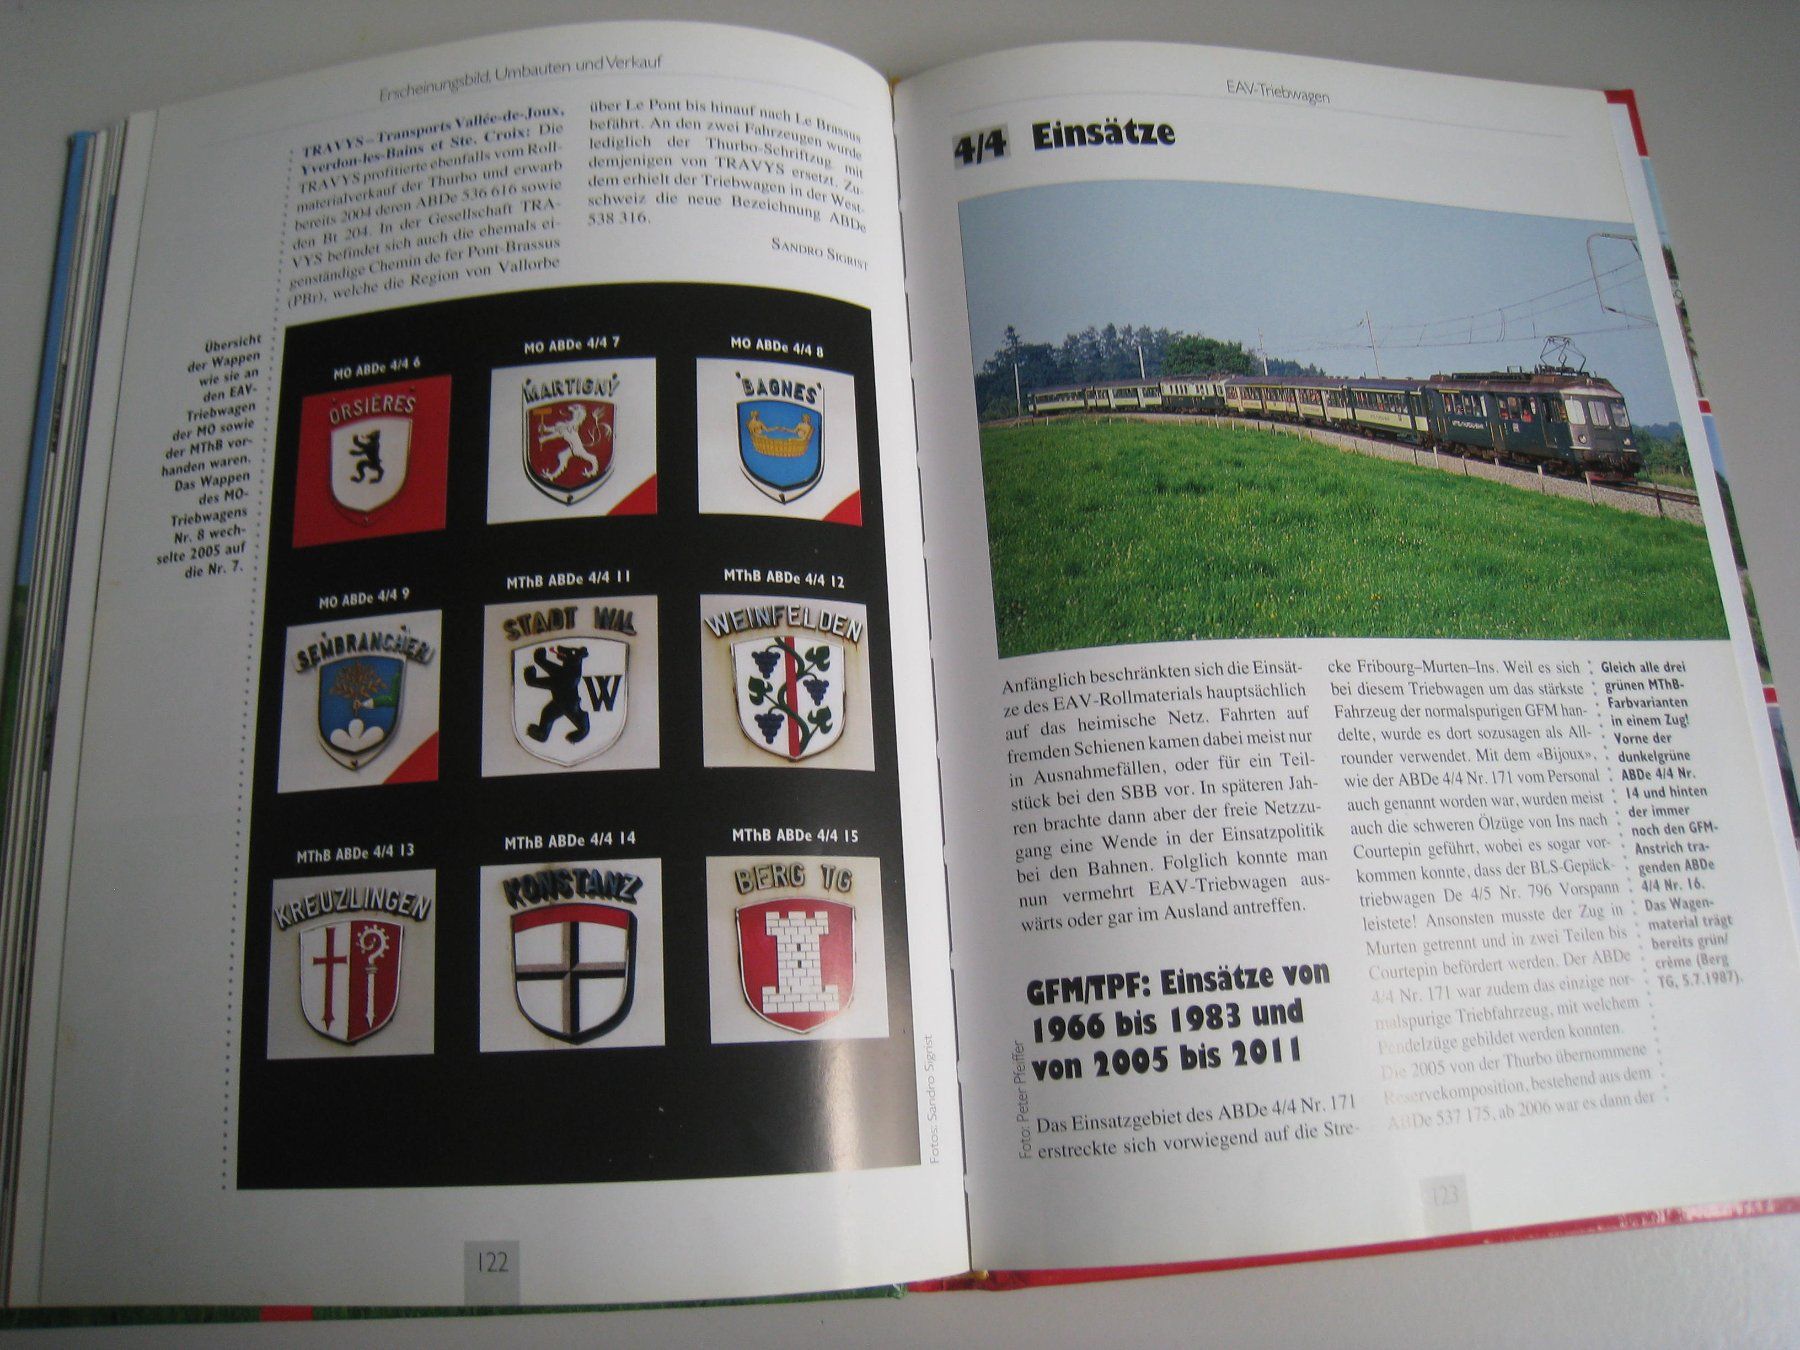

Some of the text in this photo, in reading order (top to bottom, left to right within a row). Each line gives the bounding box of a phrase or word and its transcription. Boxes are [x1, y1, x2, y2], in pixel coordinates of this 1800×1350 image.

[495, 61, 571, 81] Umbauten
[576, 57, 603, 71] und
[605, 54, 663, 69] Verkauf
[1226, 79, 1330, 105] EAV-Triebwagen
[539, 123, 564, 136] Die
[589, 98, 861, 144] über Le Pont bis hinauf nach Le Brassus
[954, 117, 1176, 166] 4/4 Einsätze
[587, 211, 650, 226] 538 316.
[205, 334, 261, 353] Übersicht
[524, 336, 620, 354] MO ABDe 4/4 7
[731, 336, 823, 358] MO ABDe 4/4 8
[187, 352, 260, 373] der Wappen
[334, 356, 421, 380] MO ABDe 4/4 6
[524, 378, 619, 403] MARTIGNY
[742, 378, 818, 404] BAGNES
[186, 401, 256, 423] Triebwagen
[172, 419, 255, 442] der MO sowie
[171, 508, 248, 527] Triebwagens
[174, 525, 246, 544] Nr. 8 wech-
[506, 570, 630, 589] MThB ABDe 4/4 11
[724, 568, 845, 588] MThB ABDe 4/4 12
[319, 587, 410, 609] MO ABDe 4/4 9
[503, 606, 636, 640] STADT WIL
[705, 605, 863, 642] WEINFELDEN
[1002, 660, 1303, 695] Anfänglich beschränkten sich die Einsät-
[1328, 661, 1351, 673] cke
[1503, 660, 1532, 674] Weil
[1538, 663, 1551, 674] es
[1556, 661, 1580, 674] sich
[1601, 662, 1686, 673] Gleich alle drei
[583, 675, 621, 711] W
[1331, 682, 1584, 698] bei diesem Triebwagen um das stärkste
[1605, 679, 1685, 693] grünen MThB-
[1004, 682, 1306, 718] ze des EAV-Rollmaterials hauptsächlich
[1608, 696, 1688, 709] Farbvarianten
[1619, 751, 1691, 764] dunkelgrüne
[1622, 768, 1696, 781] ABDe 4/4 Nr.
[505, 831, 635, 850] MThB ABDe 4/4 14
[733, 829, 858, 842] MThB ABDe 4/4 15
[296, 843, 414, 864] MThB ABDe 4/4 13
[503, 868, 642, 908] KONSTANZ
[735, 863, 853, 894] BERG TG
[274, 887, 432, 929] KREUZLINGEN
[1021, 897, 1306, 932] wärts oder gar im Ausland antreffen.
[1027, 962, 1330, 1006] GFM/TPF: Einsätze von
[1033, 998, 1304, 1043] 1966 bis 1983 und
[1014, 1041, 1027, 1085] Pfeiffer
[1032, 1036, 1300, 1081] von 2005 bis 2011
[927, 1074, 937, 1121] Sandro
[1017, 1087, 1030, 1123] Peter
[1037, 1094, 1355, 1133] Das Einsatzgebiet des ABDe 4/4 Nr. 171
[479, 1252, 509, 1272] 122
